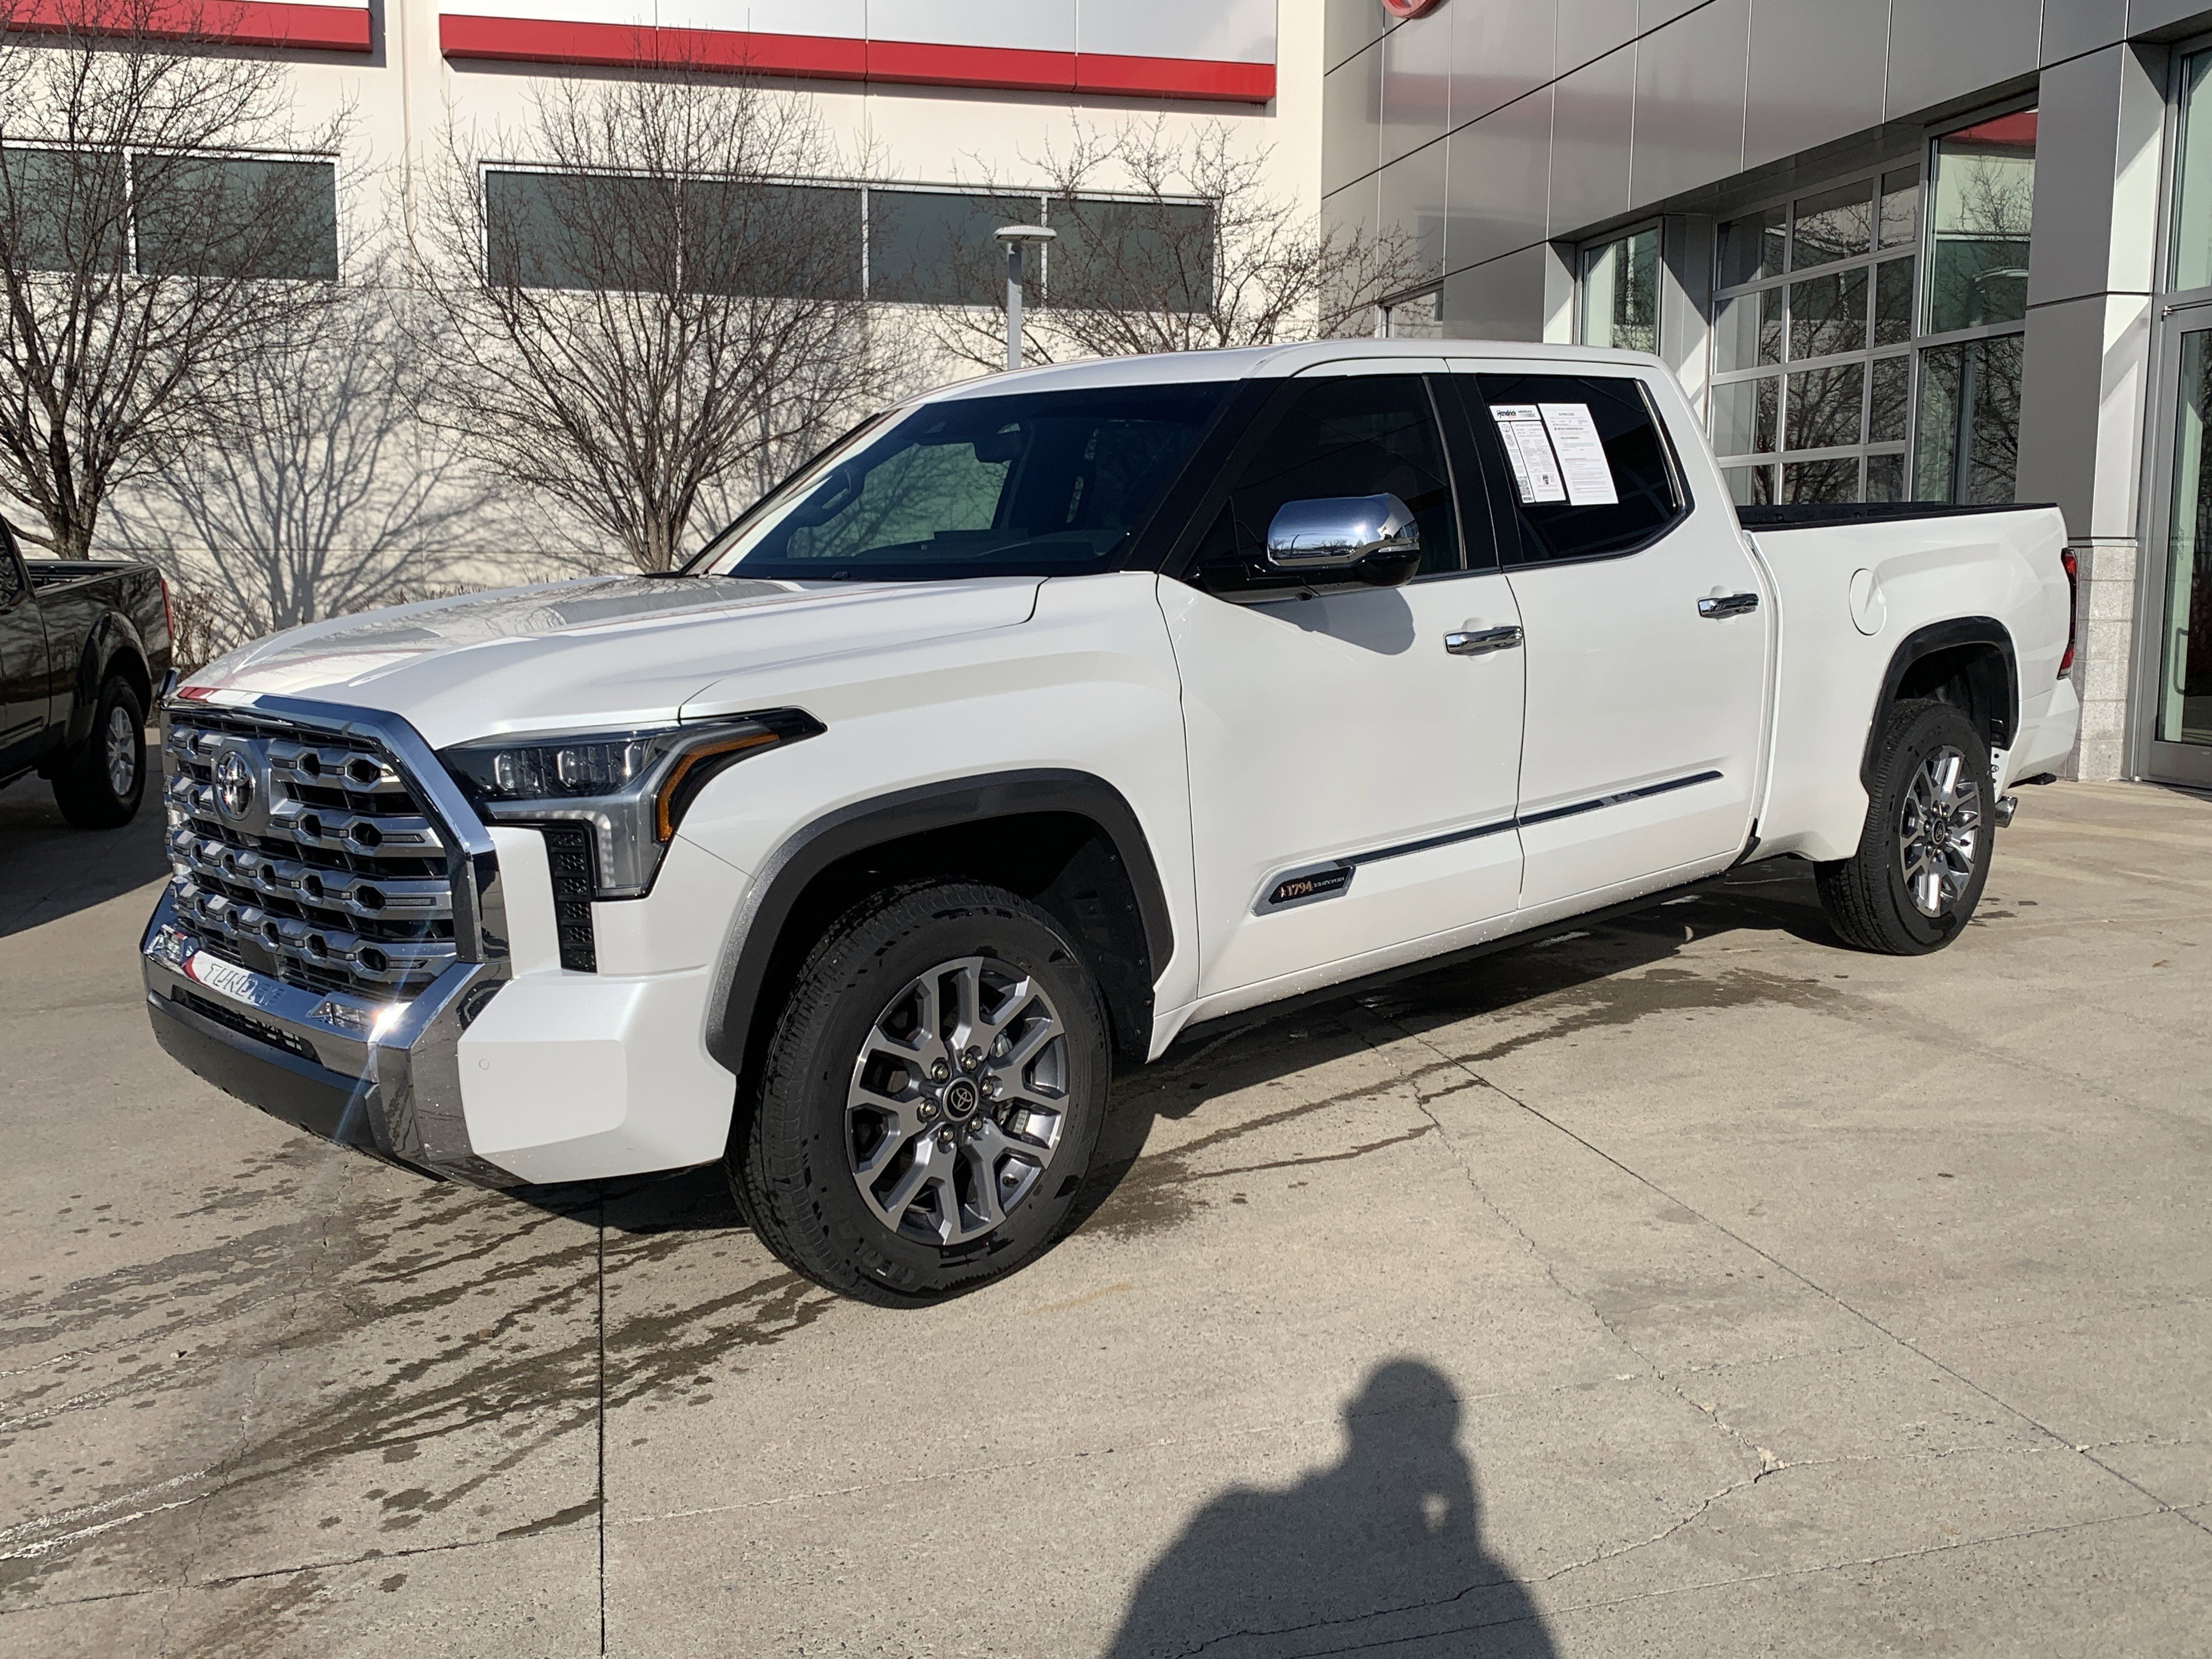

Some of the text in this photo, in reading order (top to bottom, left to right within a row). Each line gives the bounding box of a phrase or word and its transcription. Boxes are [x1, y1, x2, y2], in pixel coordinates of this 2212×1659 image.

[1497, 409, 1517, 419] Hendrick
[1286, 880, 1313, 896] 1794
[204, 963, 286, 1006] TUNDRA
